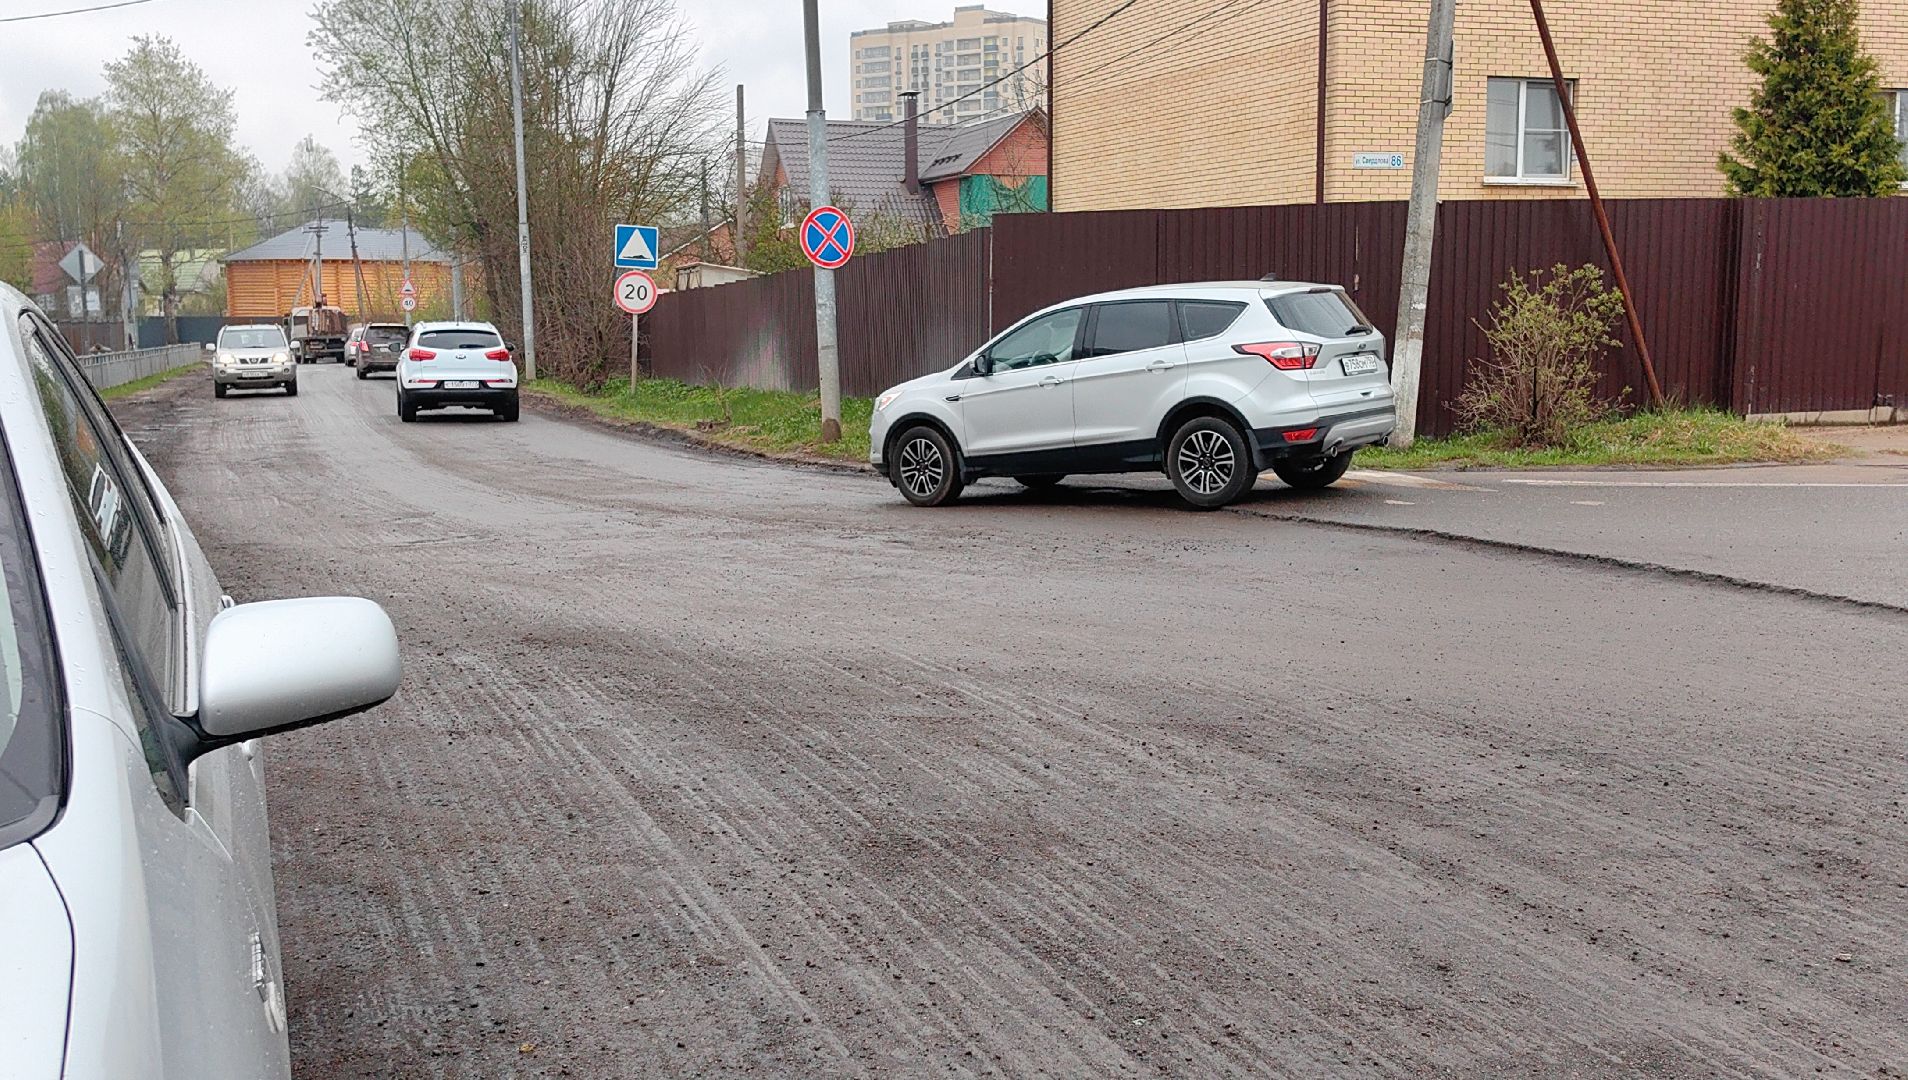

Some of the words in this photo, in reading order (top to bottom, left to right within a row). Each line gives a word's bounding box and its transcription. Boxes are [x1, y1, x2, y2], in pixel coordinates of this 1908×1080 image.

[1391, 155, 1402, 167] 86
[624, 284, 648, 301] 20
[404, 299, 414, 307] 40
